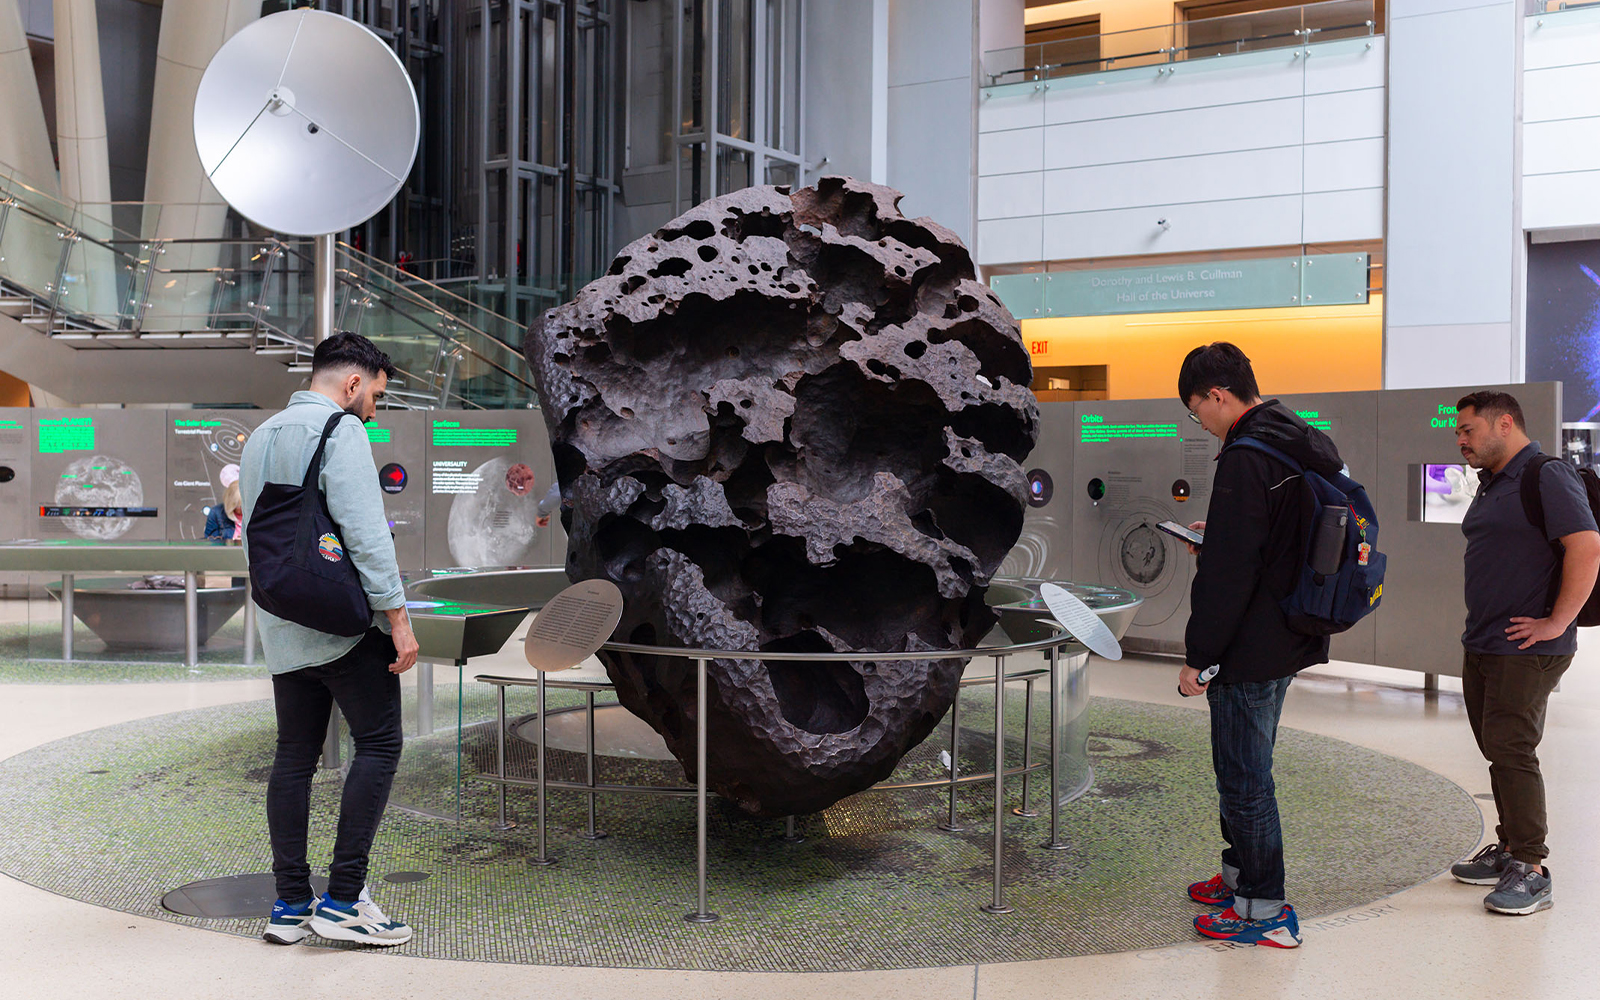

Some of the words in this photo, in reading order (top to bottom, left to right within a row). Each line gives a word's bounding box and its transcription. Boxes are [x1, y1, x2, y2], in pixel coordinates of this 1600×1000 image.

[1091, 276, 1132, 287] Dorothy
[1135, 274, 1153, 284] and
[1156, 272, 1184, 283] Lewis
[1187, 271, 1197, 281] B.
[1200, 269, 1243, 280] Cullman
[1116, 292, 1136, 302] Hall
[1138, 291, 1149, 301] of
[1151, 291, 1167, 300] the
[1170, 288, 1215, 299] Universe
[1031, 341, 1048, 354] EXIT
[432, 420, 460, 428] Surfaces
[1081, 414, 1103, 423] Orbits
[1430, 417, 1447, 428] Our
[1303, 904, 1400, 932] MERCURY
